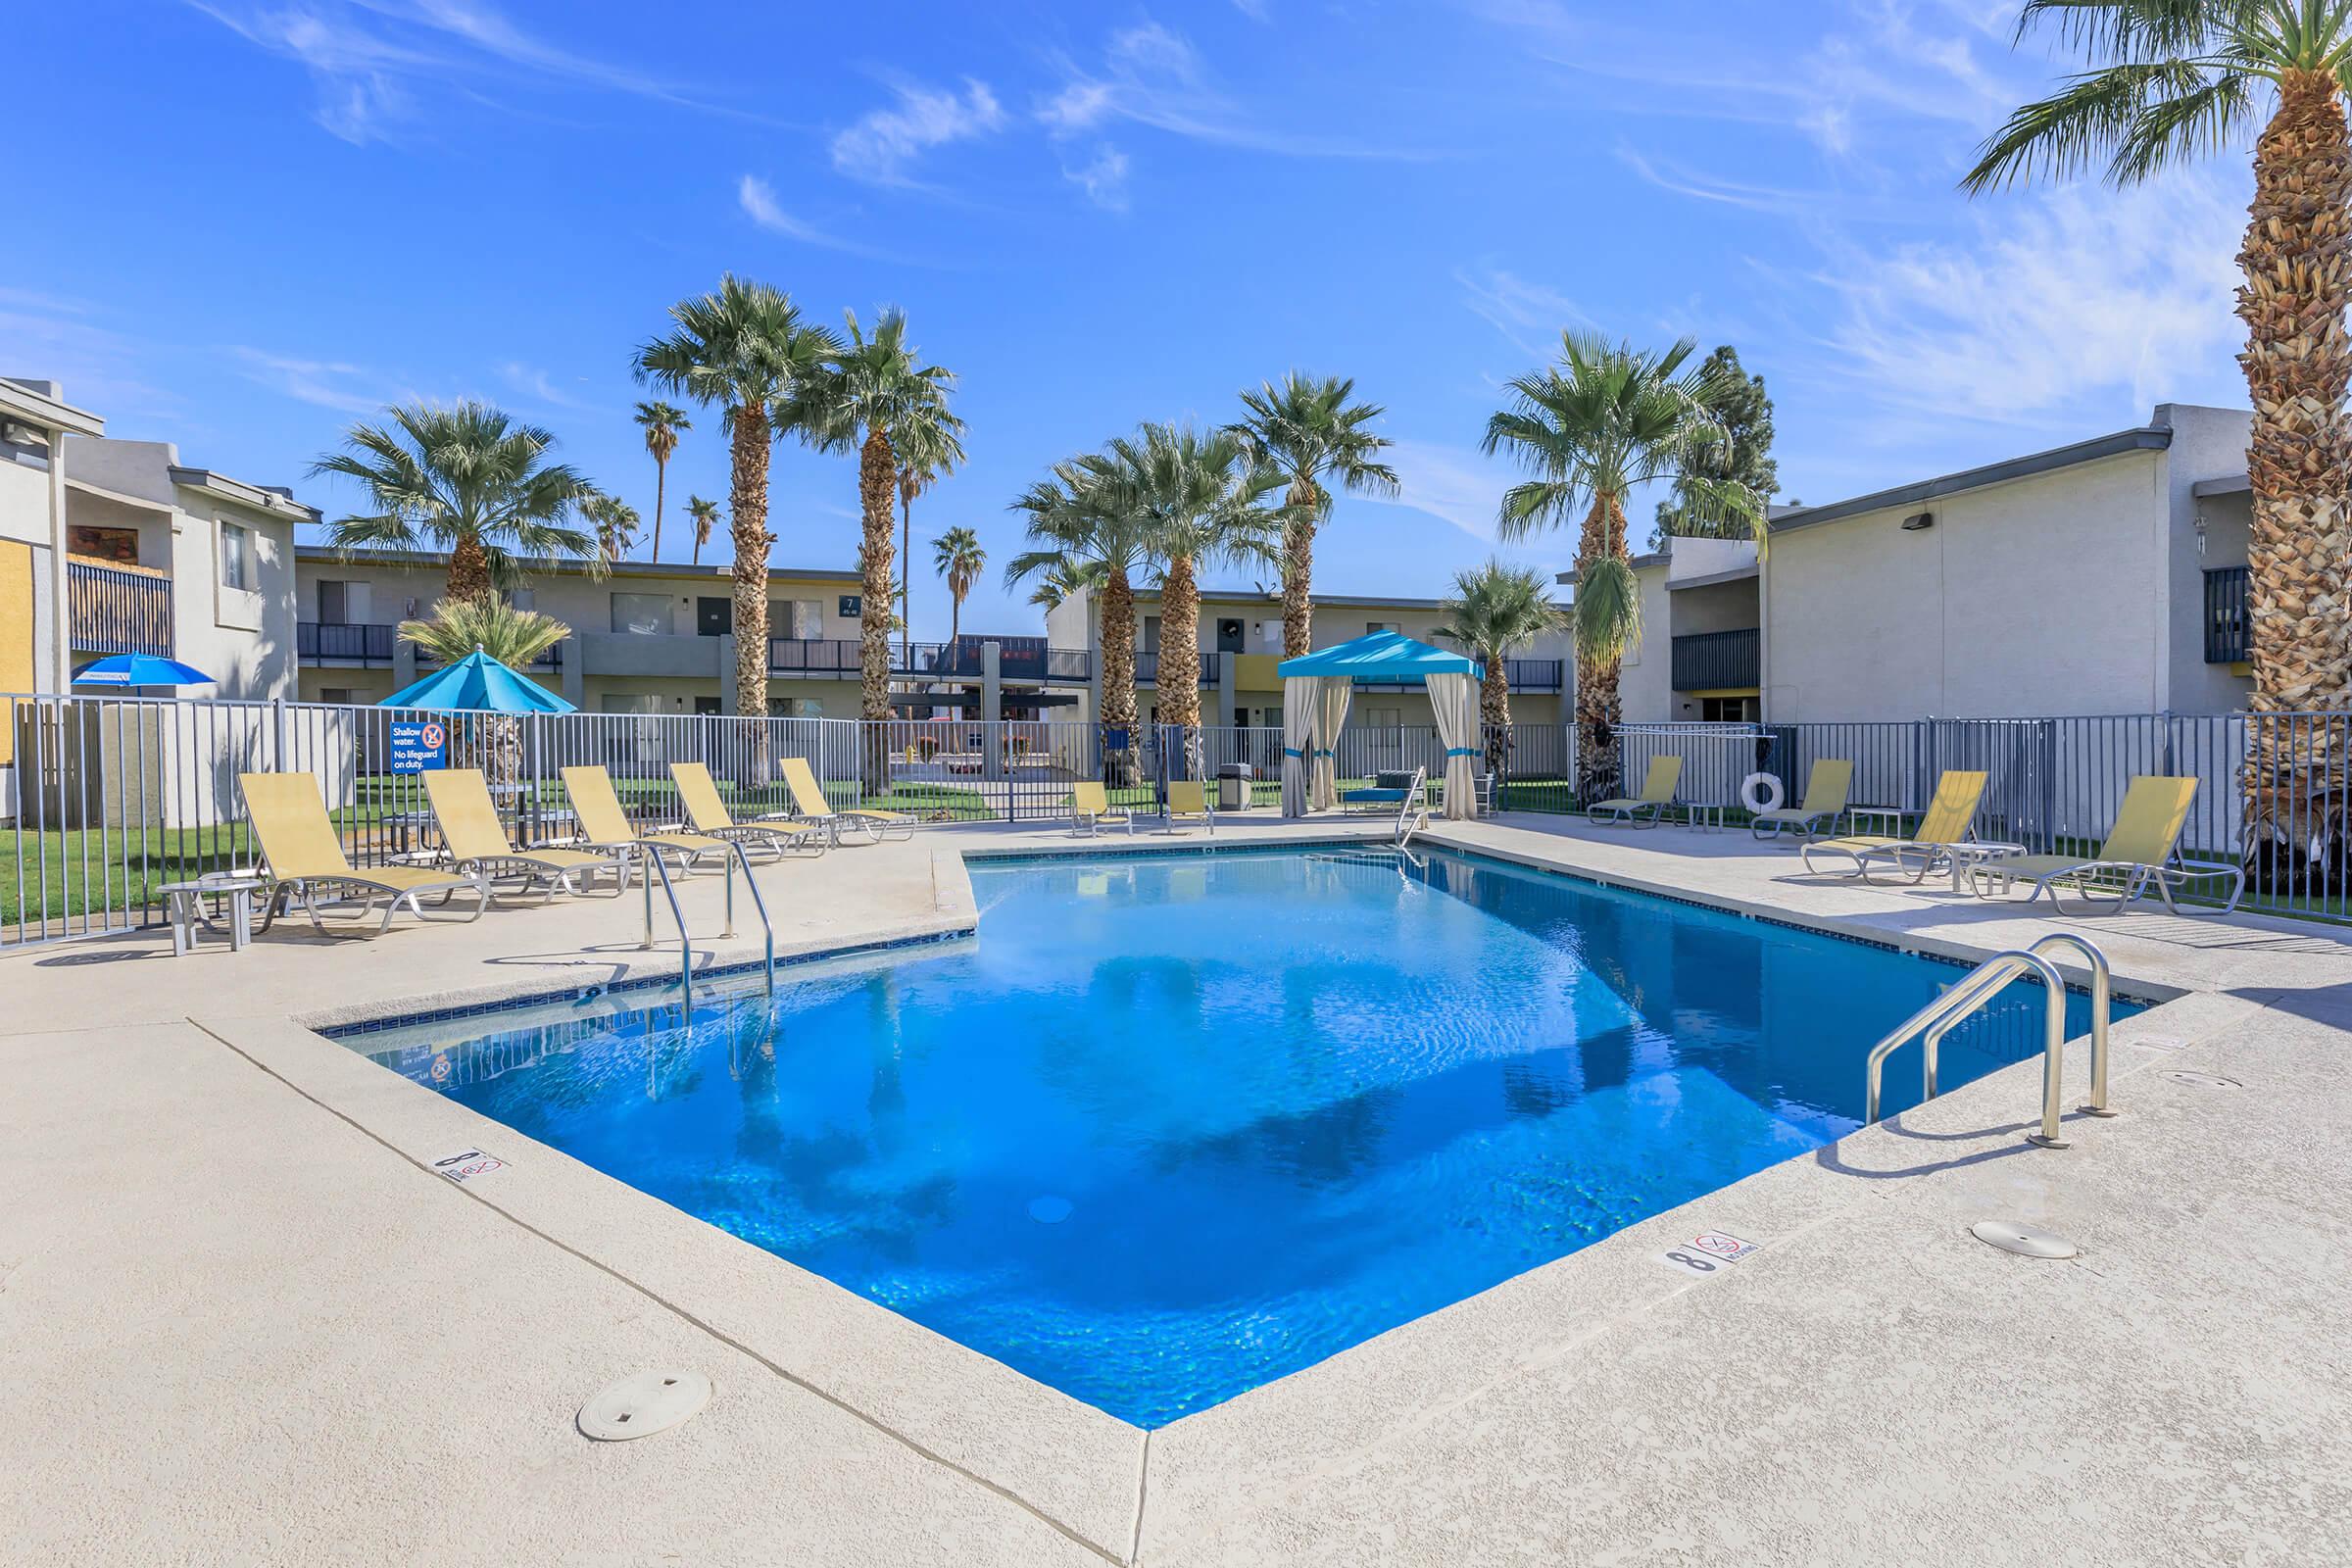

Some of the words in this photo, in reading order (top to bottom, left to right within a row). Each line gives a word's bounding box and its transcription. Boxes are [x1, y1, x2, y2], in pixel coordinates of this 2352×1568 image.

[847, 598, 854, 609] 7
[393, 727, 421, 736] Shallow
[394, 751, 407, 760] No
[407, 749, 438, 760] lifeguard
[405, 760, 423, 769] duty.
[434, 1152, 480, 1167] 8
[1666, 1251, 1717, 1272] 8
